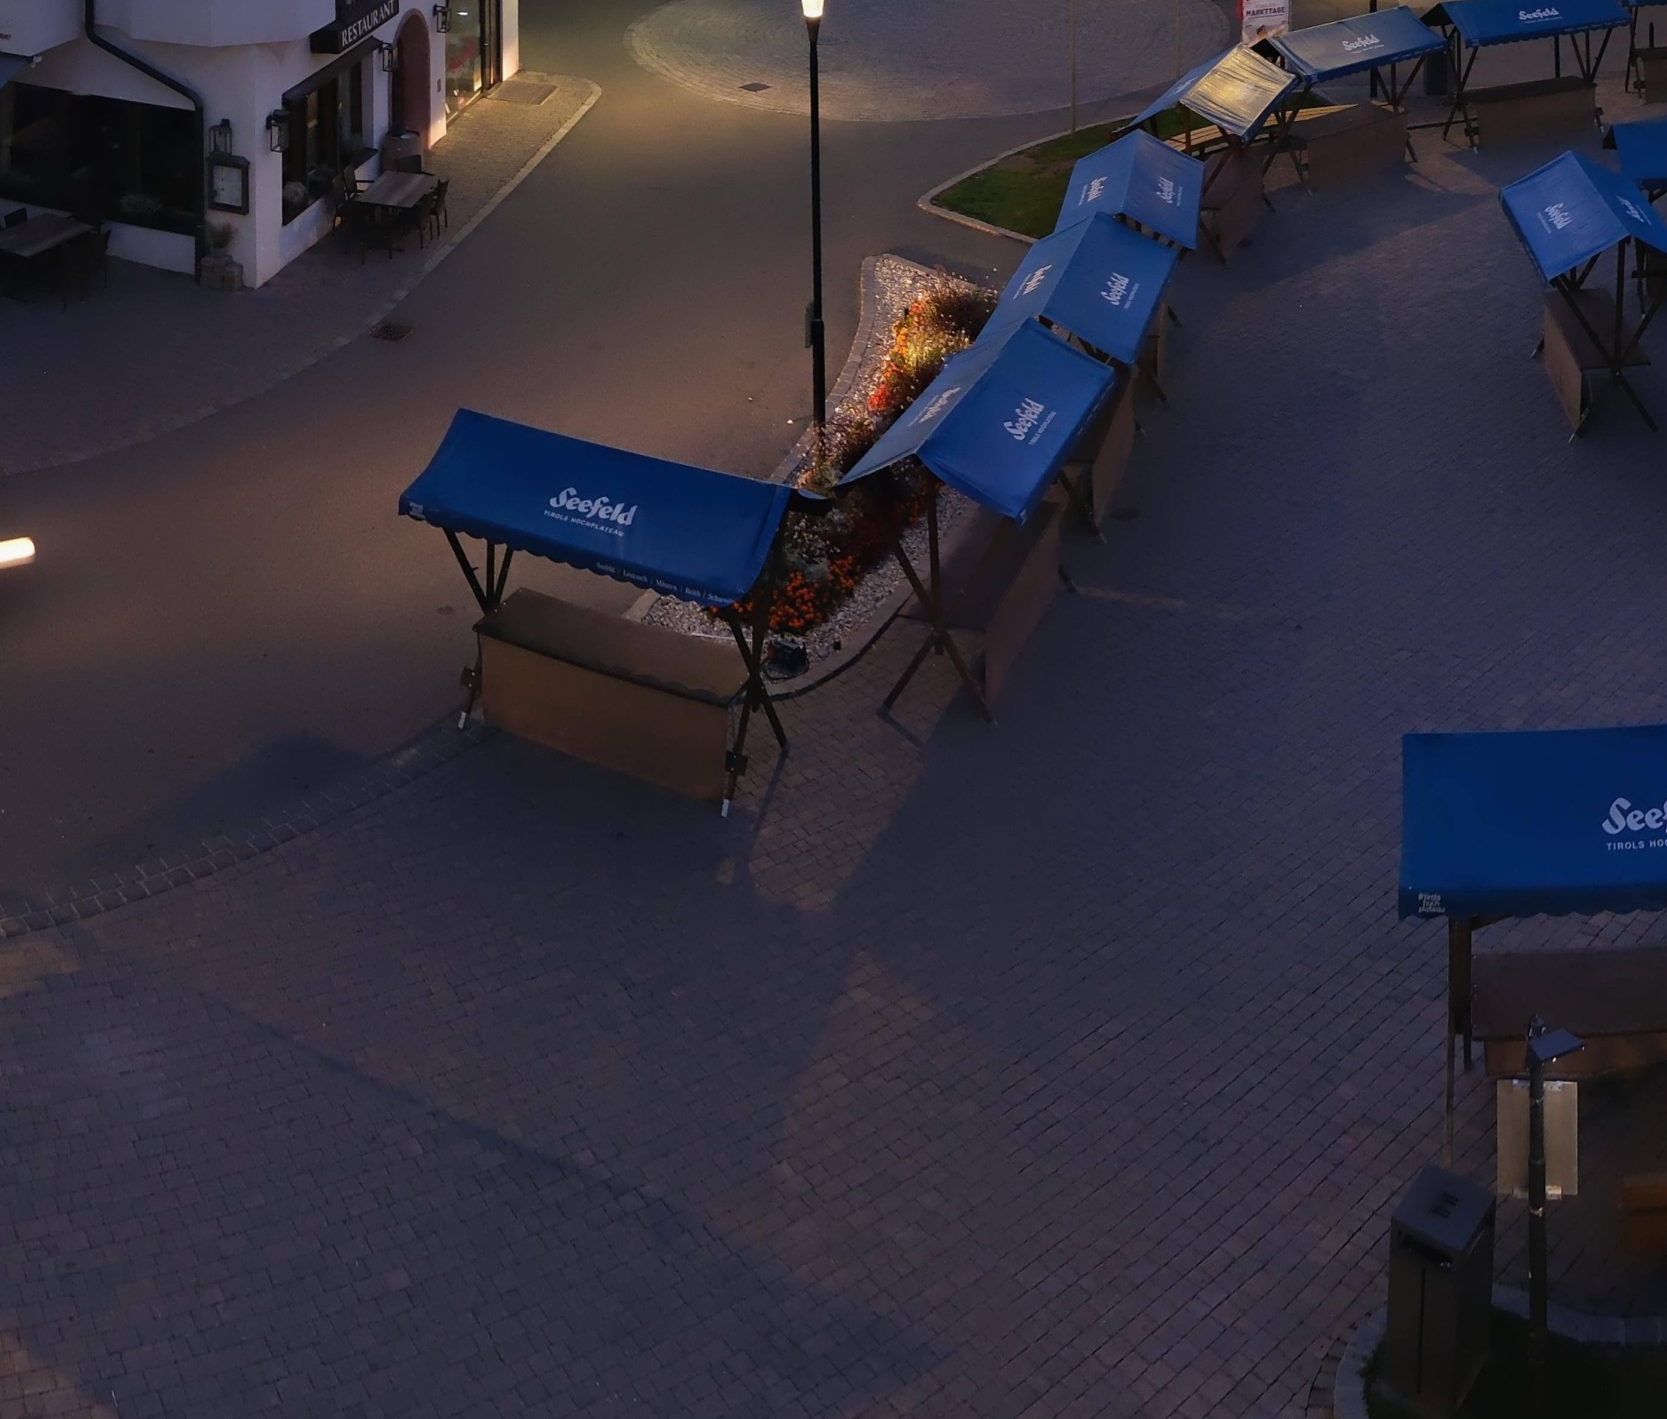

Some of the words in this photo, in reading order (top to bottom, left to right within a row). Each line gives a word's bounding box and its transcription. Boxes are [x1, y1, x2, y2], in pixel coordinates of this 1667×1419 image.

[1245, 7, 1286, 17] MARKTTAGE
[1519, 7, 1560, 21] Seefeld
[340, 0, 395, 47] RESTAURANT
[1342, 34, 1380, 51] Seefeld
[1003, 398, 1044, 441] Seefeld
[549, 486, 639, 526] Seefeld
[543, 509, 568, 523] TIROLS
[1606, 839, 1645, 852] TIROLS
